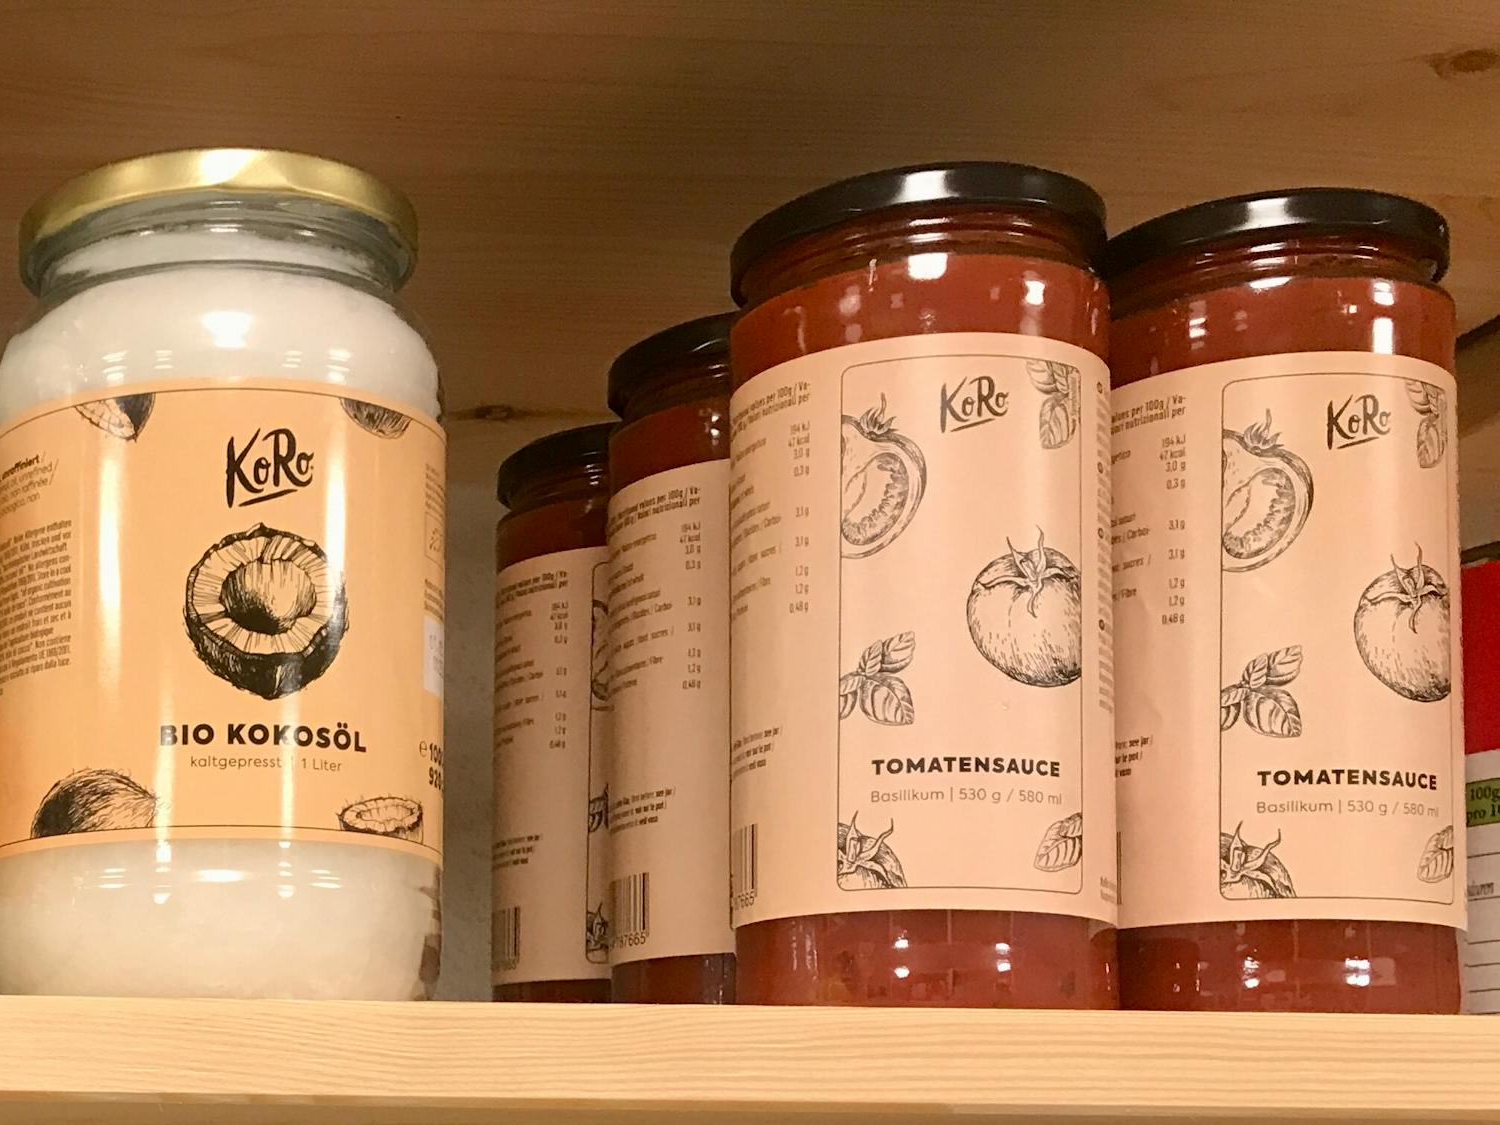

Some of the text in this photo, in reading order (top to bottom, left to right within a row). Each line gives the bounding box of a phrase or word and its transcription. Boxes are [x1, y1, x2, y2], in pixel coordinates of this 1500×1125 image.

[940, 375, 1009, 432] KoRo
[1326, 394, 1391, 450] KoRo
[226, 427, 314, 508] KoRo
[160, 722, 366, 753] BIO KOKOSÖL
[190, 753, 282, 771] kaltgepresst
[312, 757, 342, 773] Liter
[871, 755, 1061, 778] TOMATENSAUCE
[1257, 768, 1438, 792] TOMATENSAUCE
[871, 788, 945, 804] Basilikum
[958, 788, 987, 804] 530
[991, 791, 1002, 807] g
[1018, 790, 1044, 805] 580
[1047, 791, 1062, 806] ml
[1256, 800, 1334, 816] Basilikum
[1347, 800, 1374, 816] 530
[1378, 803, 1389, 818] g
[1402, 802, 1425, 817] 580
[1427, 803, 1440, 818] ml
